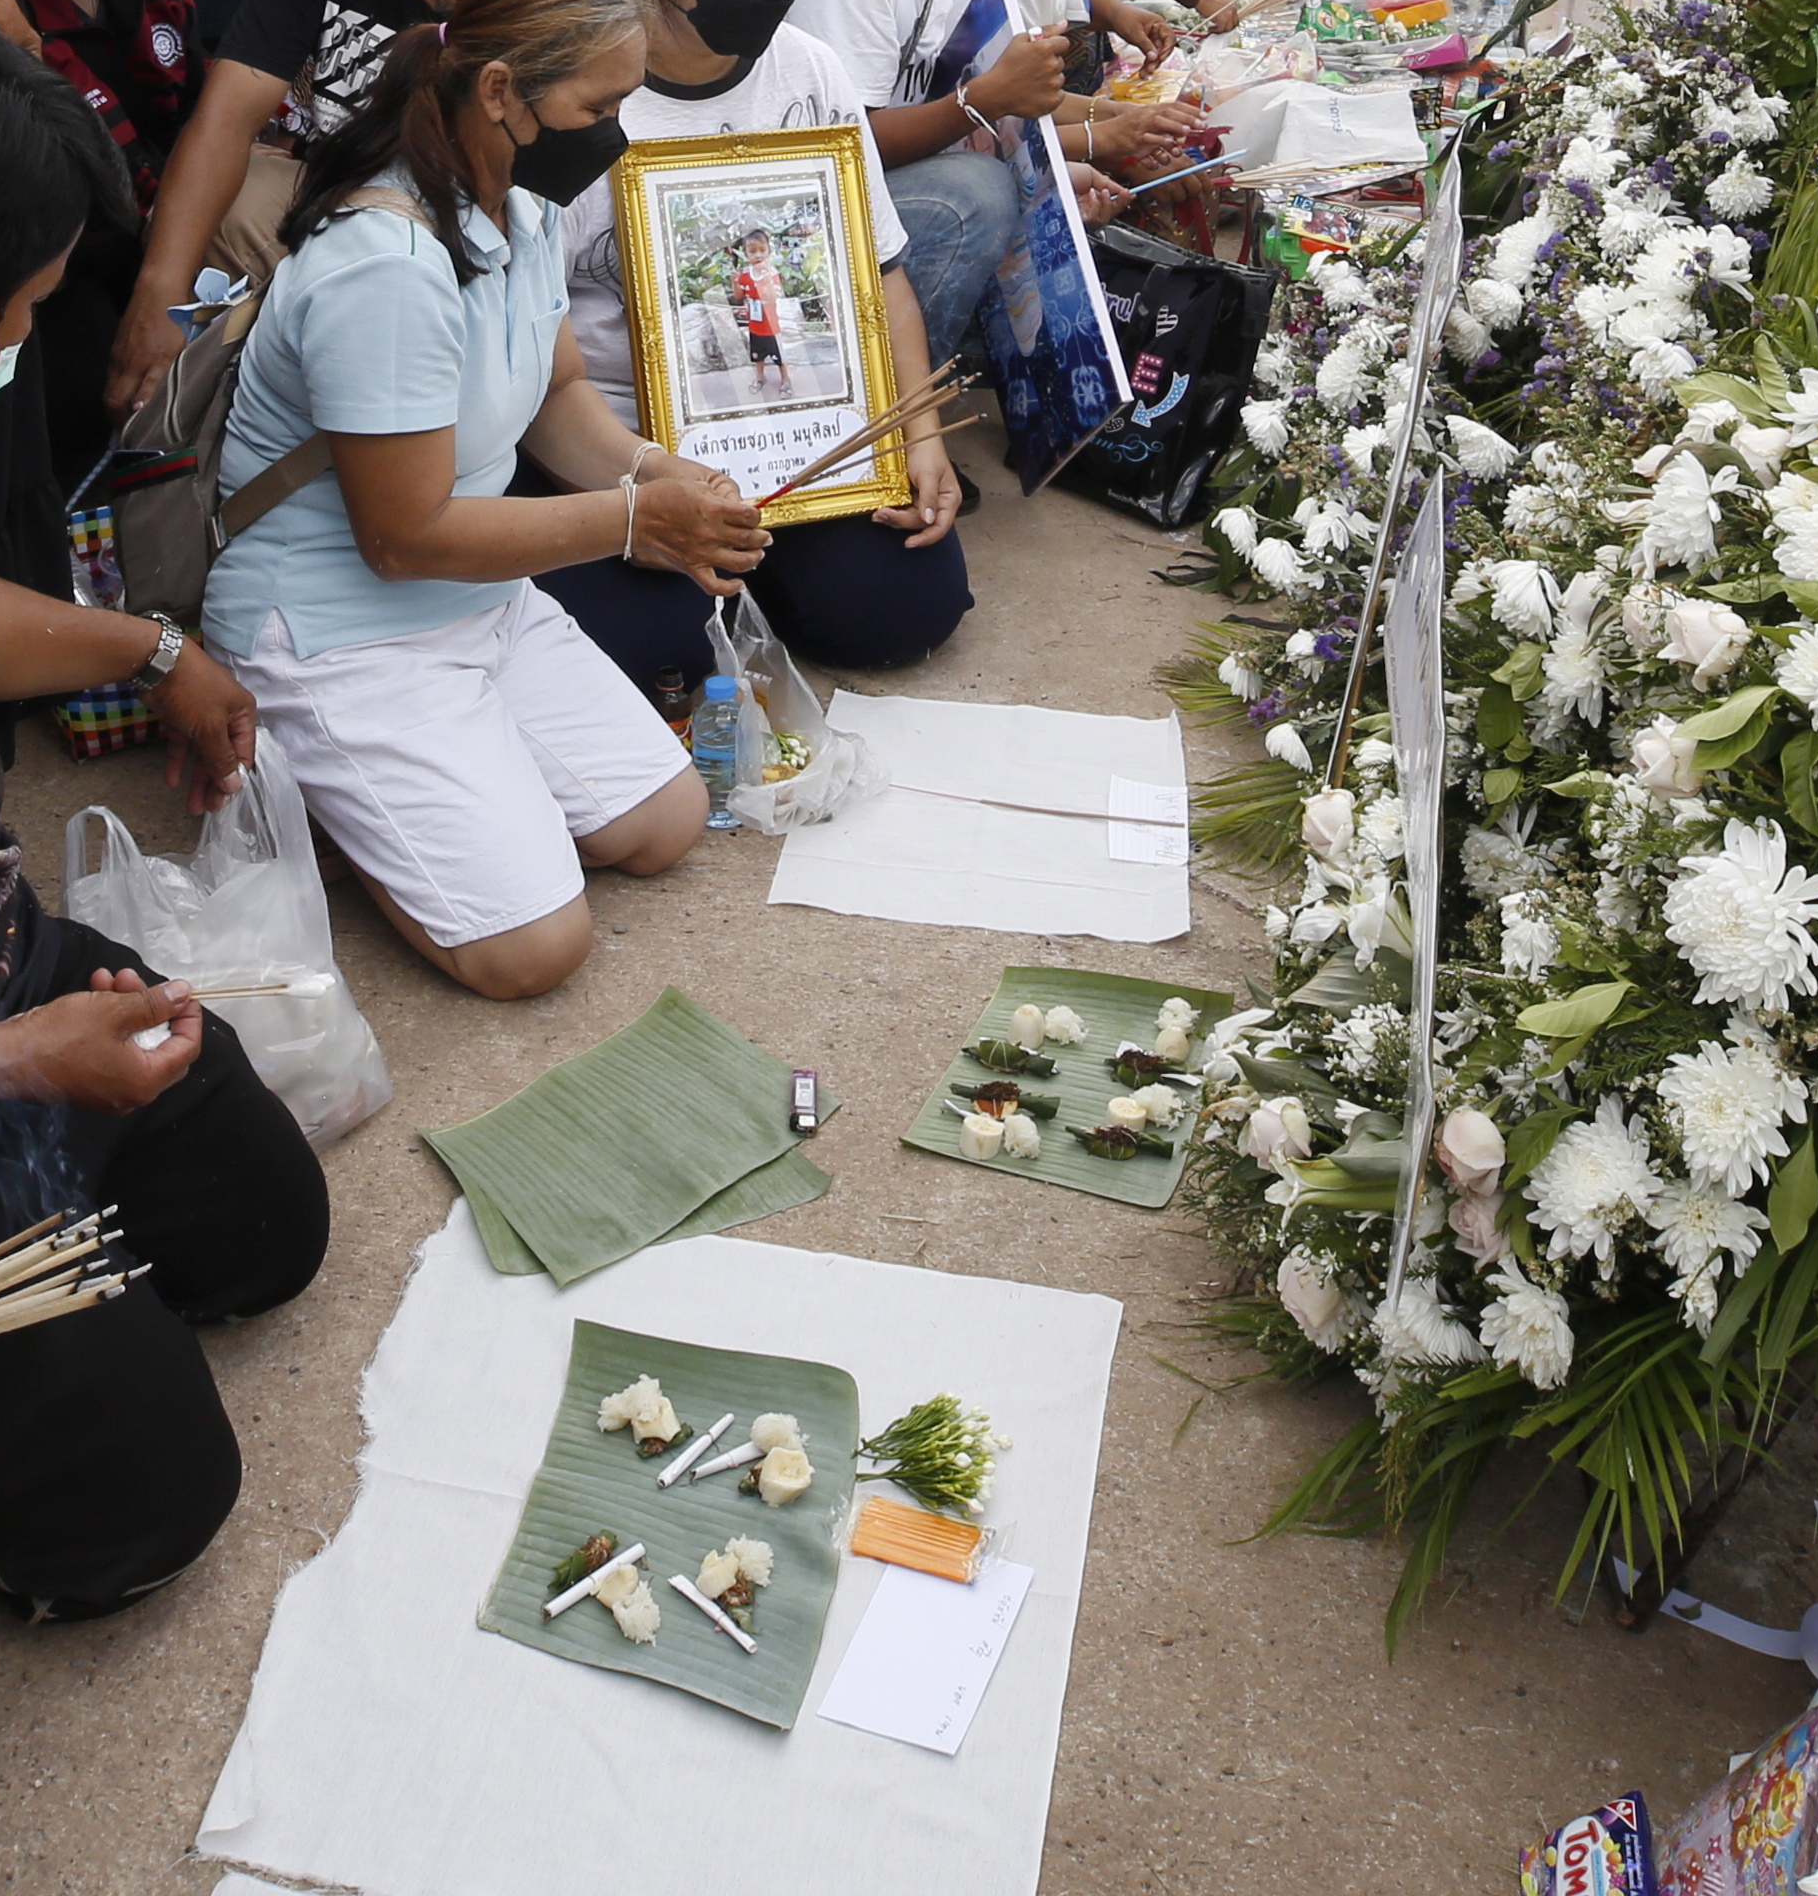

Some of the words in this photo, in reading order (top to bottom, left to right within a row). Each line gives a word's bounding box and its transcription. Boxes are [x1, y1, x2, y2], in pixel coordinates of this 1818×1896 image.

[693, 429, 787, 457] เด็กชายชฎายุ
[792, 410, 843, 448] มนูศิลป์
[767, 457, 807, 472] กรกฎาคม
[1561, 1819, 1601, 1896] TOM
